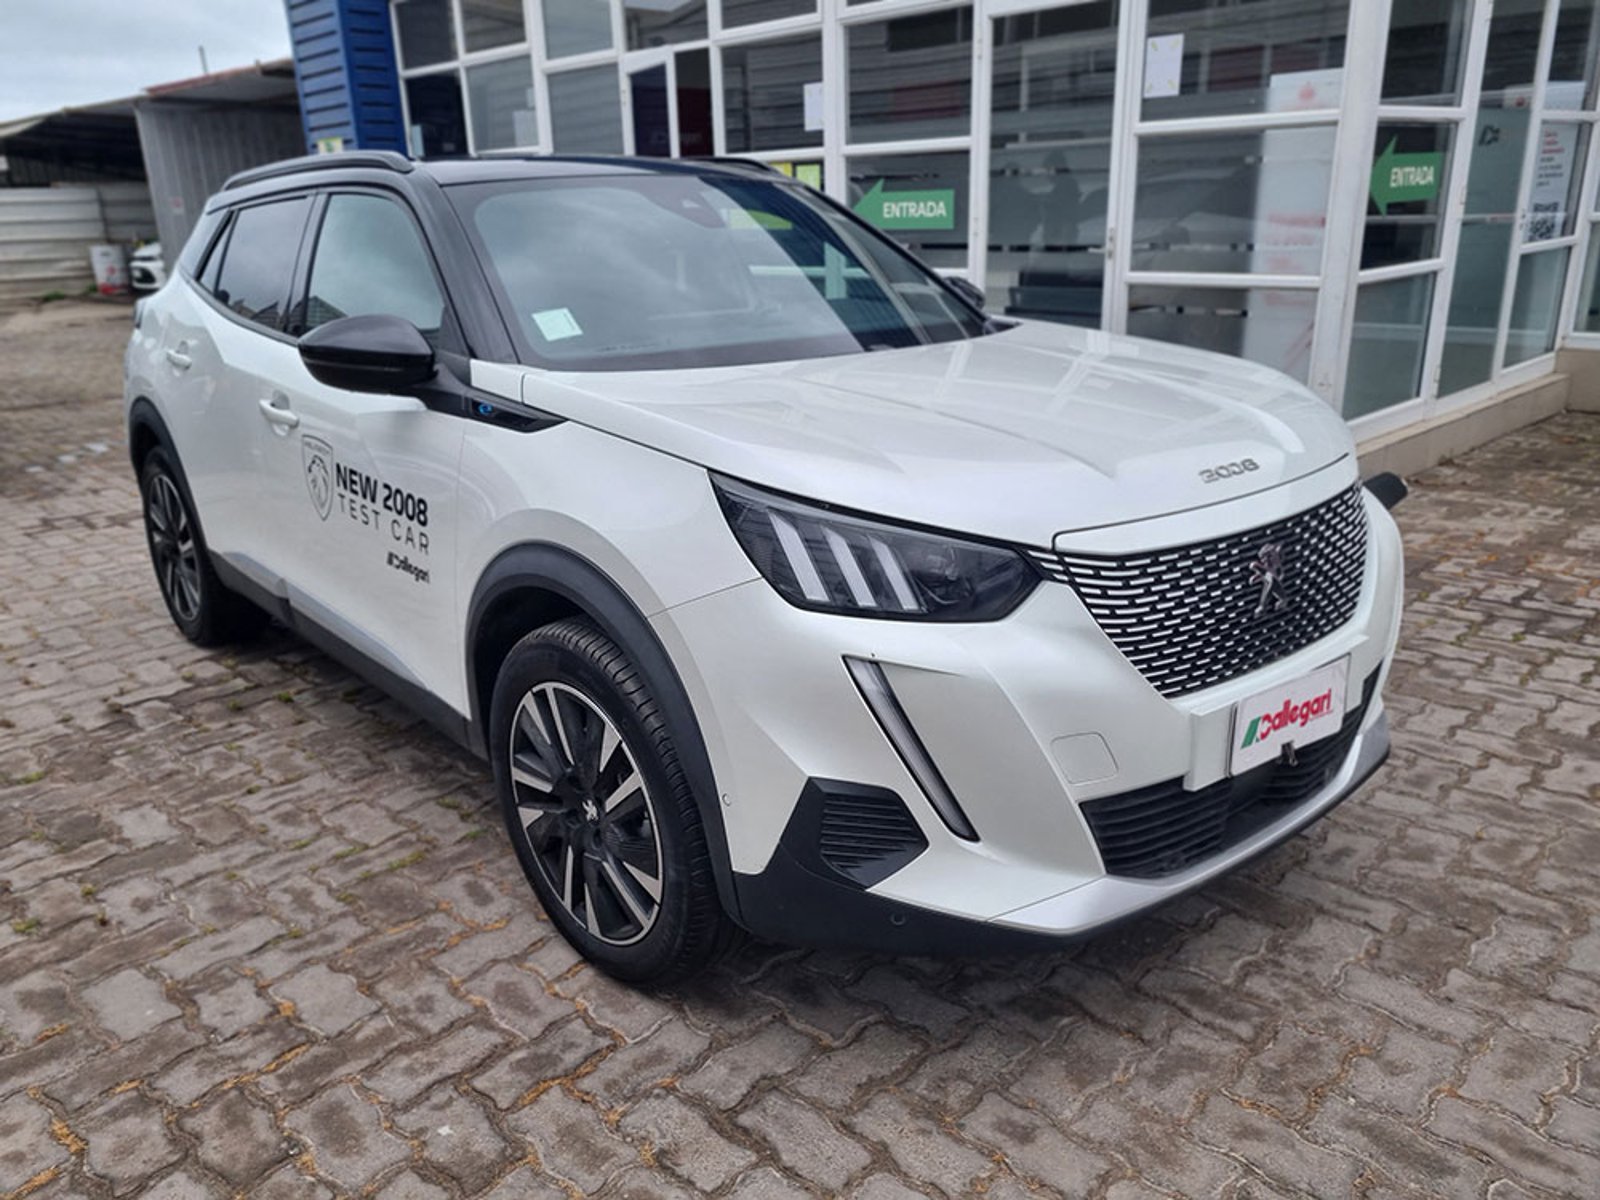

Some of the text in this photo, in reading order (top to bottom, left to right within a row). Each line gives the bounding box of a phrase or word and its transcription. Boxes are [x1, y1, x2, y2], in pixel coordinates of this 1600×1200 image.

[883, 201, 947, 218] ENTRADA
[335, 462, 428, 527] NEW 2008
[337, 492, 429, 555] TEST CAR
